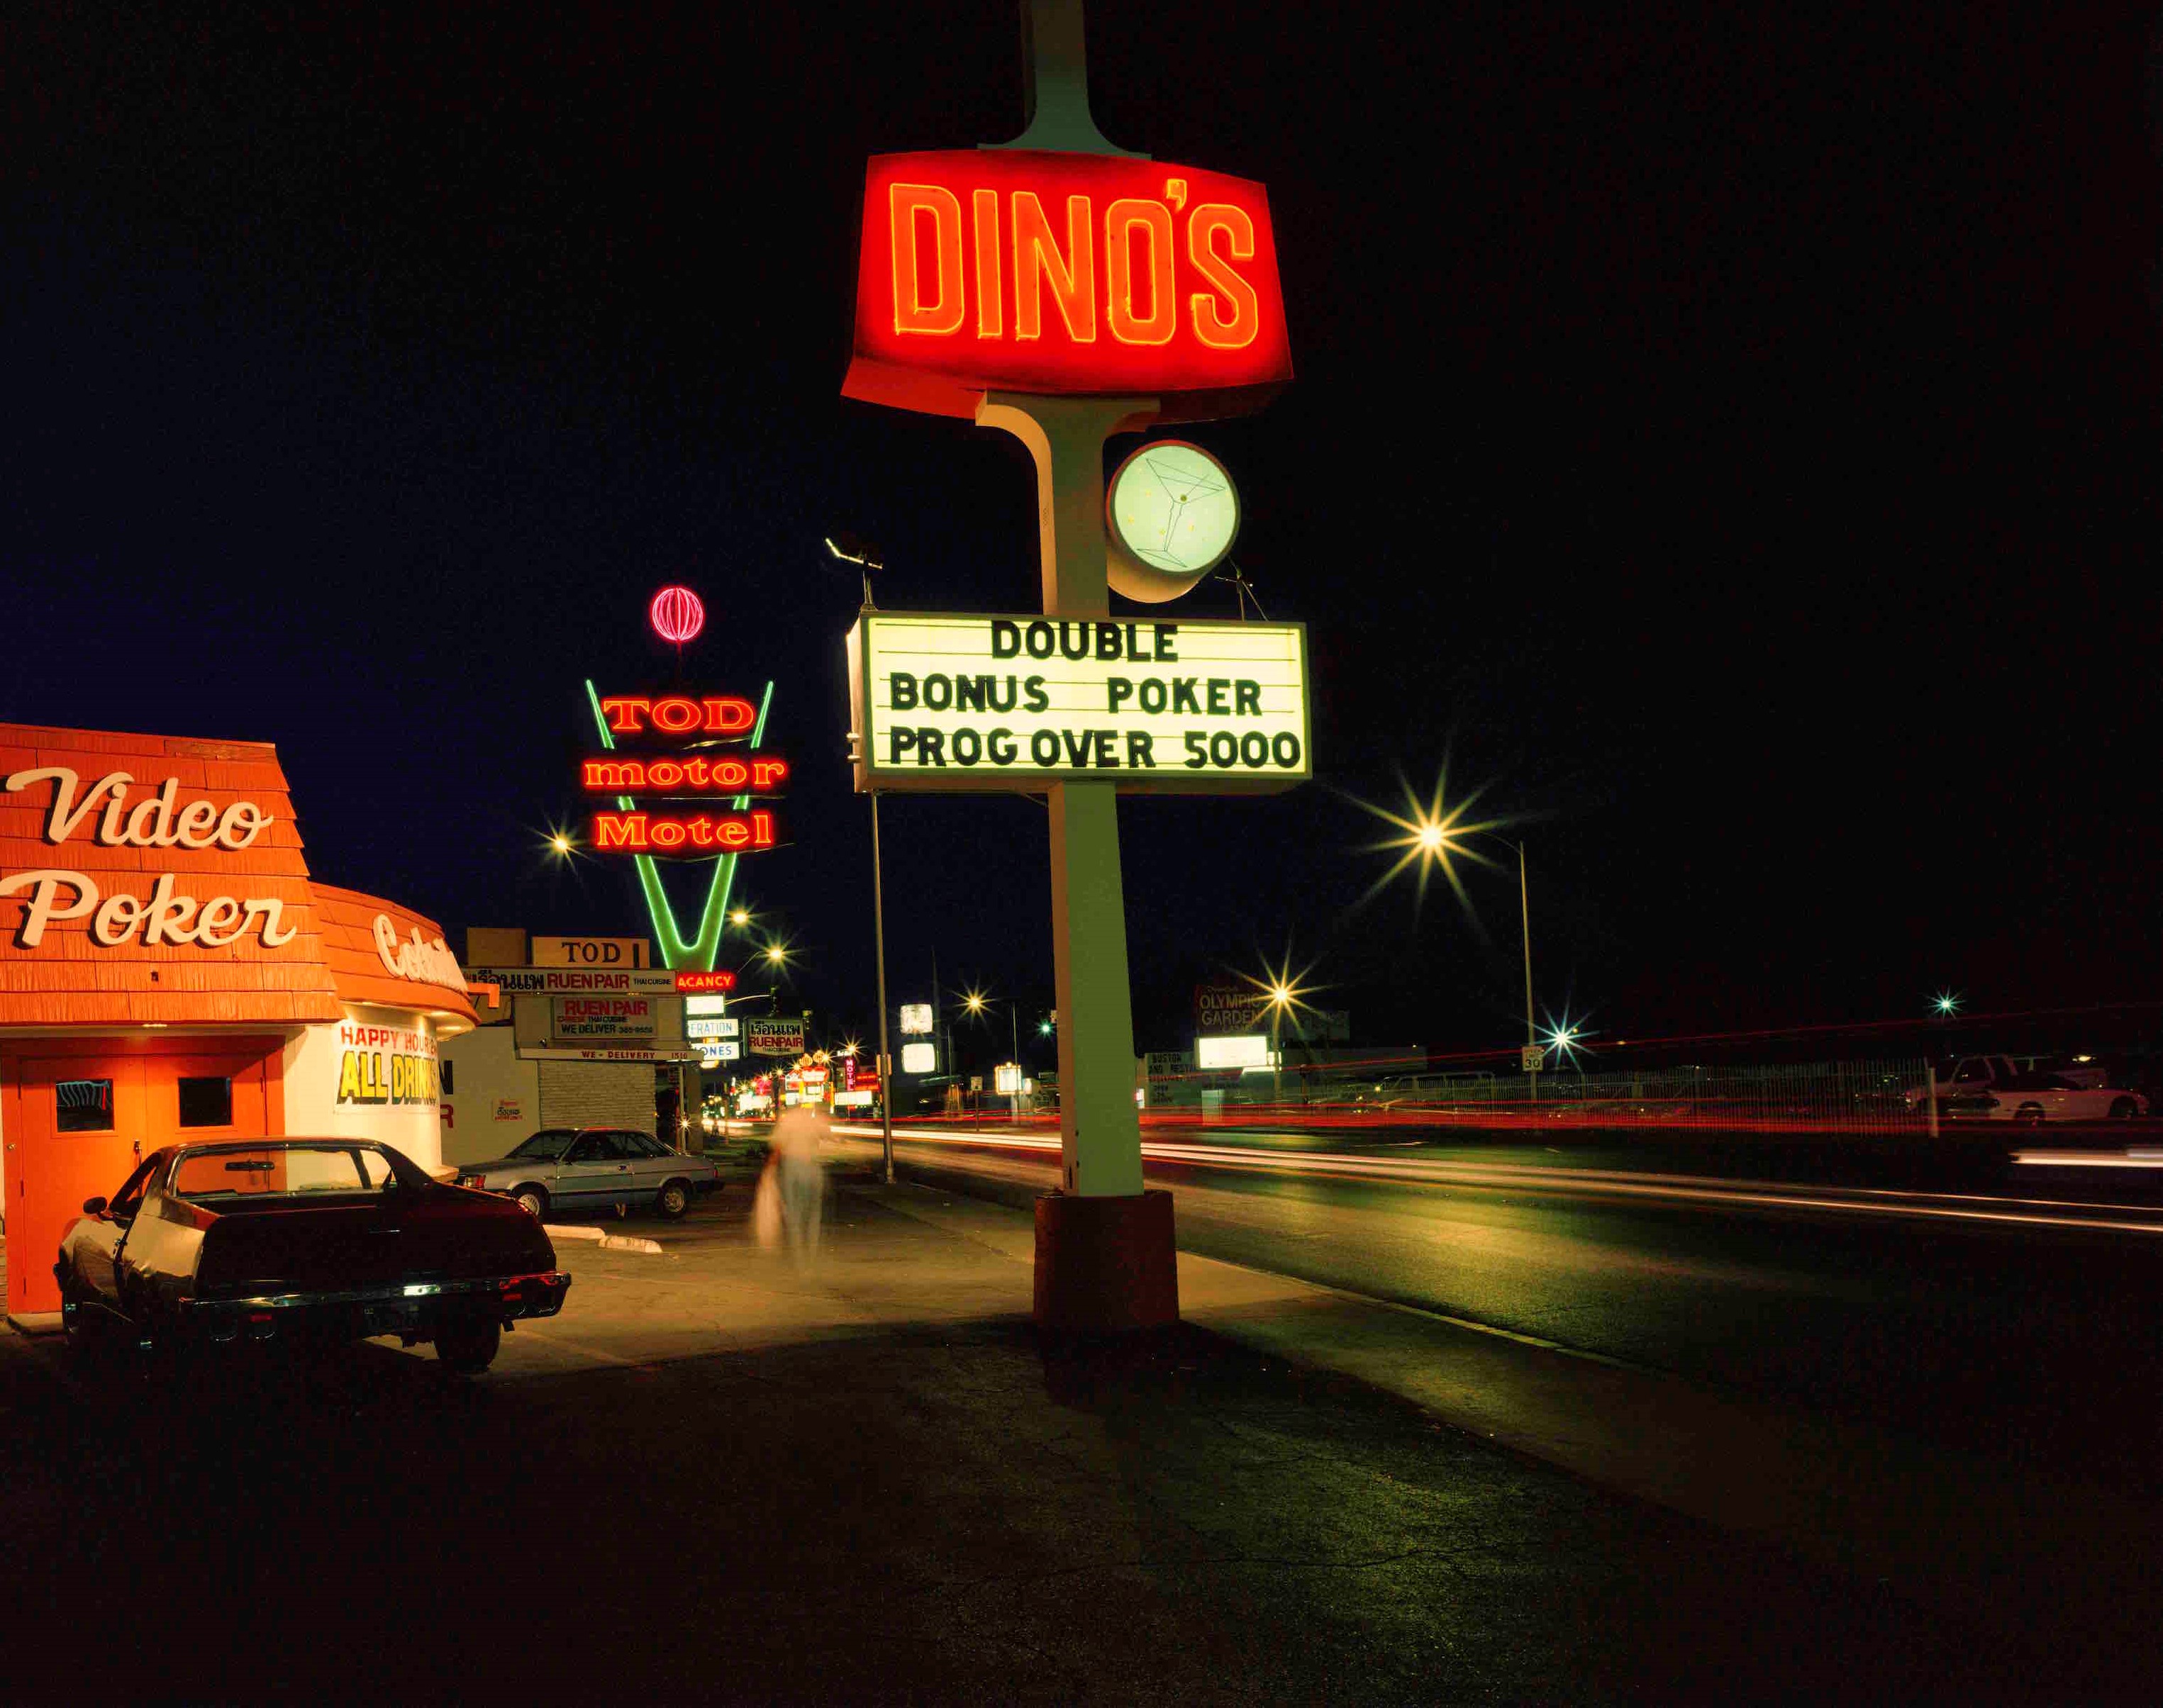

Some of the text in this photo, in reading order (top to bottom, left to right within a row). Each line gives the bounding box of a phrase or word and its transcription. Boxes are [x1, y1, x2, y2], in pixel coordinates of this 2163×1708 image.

[889, 179, 1259, 348] DINO'S
[992, 620, 1178, 662] DOUBLE
[889, 672, 1262, 715] BONUS POKER
[603, 699, 755, 730] TOD
[889, 725, 1300, 769] PROG OVER 5000
[584, 758, 785, 786] motor
[5, 766, 274, 849] Video
[596, 815, 773, 846] Motel
[0, 869, 296, 947] Poker
[562, 942, 621, 963] TOD
[340, 1026, 399, 1049] HAPPY
[562, 1024, 577, 1034] WE
[578, 1024, 616, 1034] DELIVER
[582, 1051, 596, 1059] WE
[694, 1046, 732, 1056] ONES
[1525, 1059, 1540, 1068] 30
[337, 1051, 388, 1105] ALL
